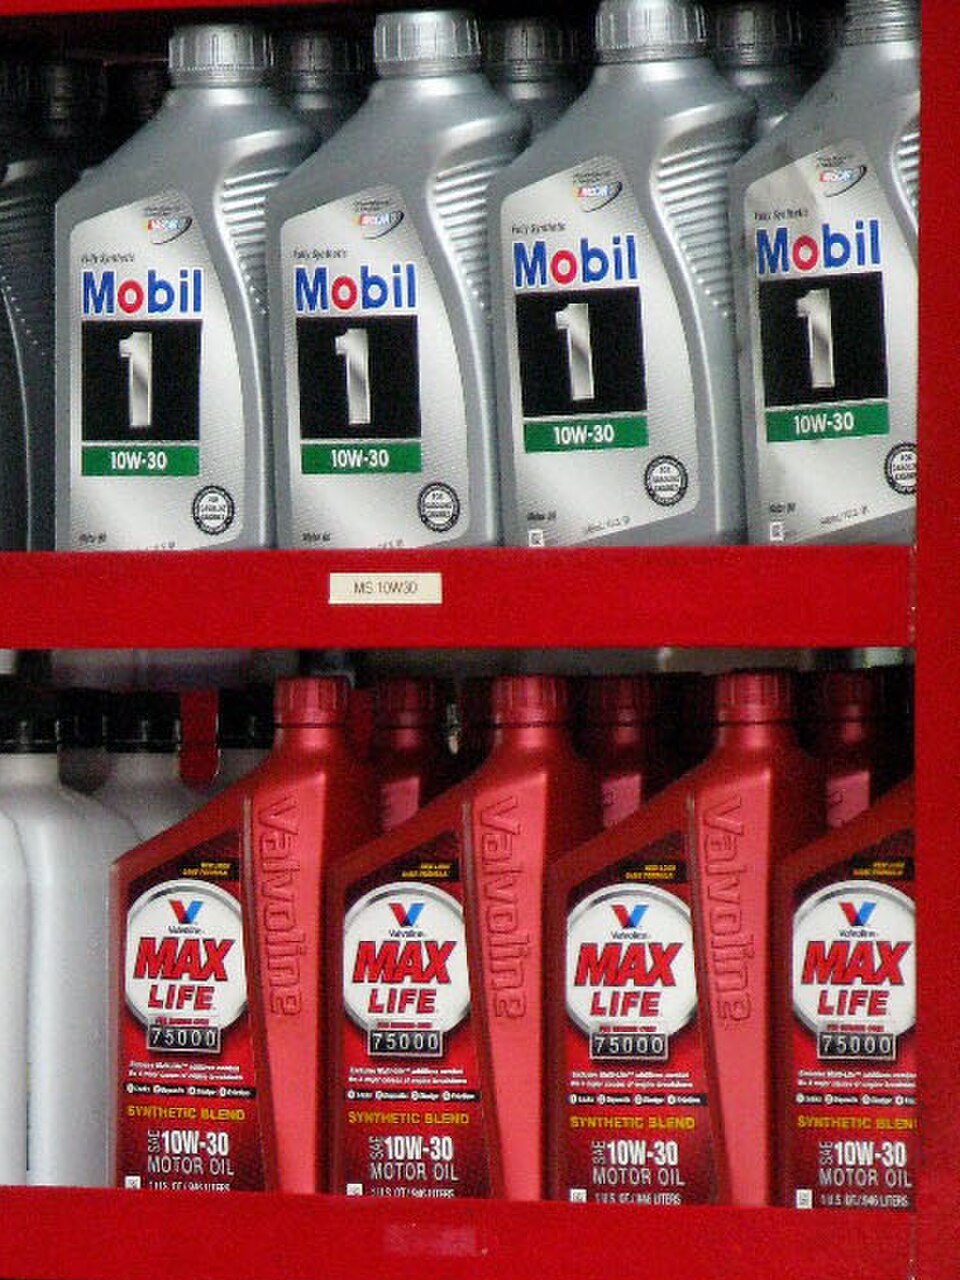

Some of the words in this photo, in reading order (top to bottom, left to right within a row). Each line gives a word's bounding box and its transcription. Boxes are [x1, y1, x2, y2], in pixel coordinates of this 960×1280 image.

[756, 220, 881, 274] Mobil
[513, 234, 638, 287] Mobil
[82, 269, 202, 313] Mobil
[295, 263, 416, 312] Mobil
[555, 302, 595, 400] 1
[796, 289, 836, 389] 1
[119, 331, 152, 427] 1
[335, 328, 371, 425] 1
[793, 411, 854, 432] 10W-30
[553, 425, 615, 444] 10W-30
[110, 451, 168, 469] 10W-30
[330, 448, 390, 468] 10W-30
[354, 581, 374, 594] MS
[377, 581, 418, 594] 10W30
[257, 795, 306, 1016] Valvoline
[481, 796, 530, 1019] Valvoline
[704, 795, 755, 1021] Valvoline
[133, 937, 235, 981] MAX
[352, 940, 457, 984] MAX
[574, 942, 683, 987] MAX
[801, 940, 912, 986] MAX
[147, 985, 215, 1010] LIFE
[367, 989, 437, 1014] LIFE
[591, 991, 662, 1017] LIFE
[817, 990, 890, 1016] LIFE
[150, 1027, 217, 1047] 75000
[372, 1032, 439, 1050] 75000
[594, 1036, 664, 1053] 75000
[822, 1035, 891, 1053] 75000
[127, 1106, 197, 1120] SYNTHETIC
[200, 1108, 246, 1121] BLEND
[348, 1111, 420, 1124] SYNTHETIC
[424, 1113, 470, 1125] BLEND
[570, 1115, 644, 1128] SYNTHETIC
[649, 1116, 696, 1129] BLEND
[798, 1115, 872, 1129] SYNTHETIC
[161, 1130, 229, 1156] 10W-30
[385, 1136, 453, 1161] 10W-30
[607, 1140, 679, 1166] 10W-30
[835, 1141, 907, 1166] 10W-30
[147, 1156, 204, 1174] MOTOR
[209, 1158, 235, 1176] OIL
[370, 1162, 427, 1180] MOTOR
[435, 1163, 459, 1181] OIL
[593, 1168, 652, 1185] MOTOR
[658, 1168, 685, 1186] OIL
[819, 1169, 878, 1186] MOTOR
[885, 1169, 912, 1187] OIL
